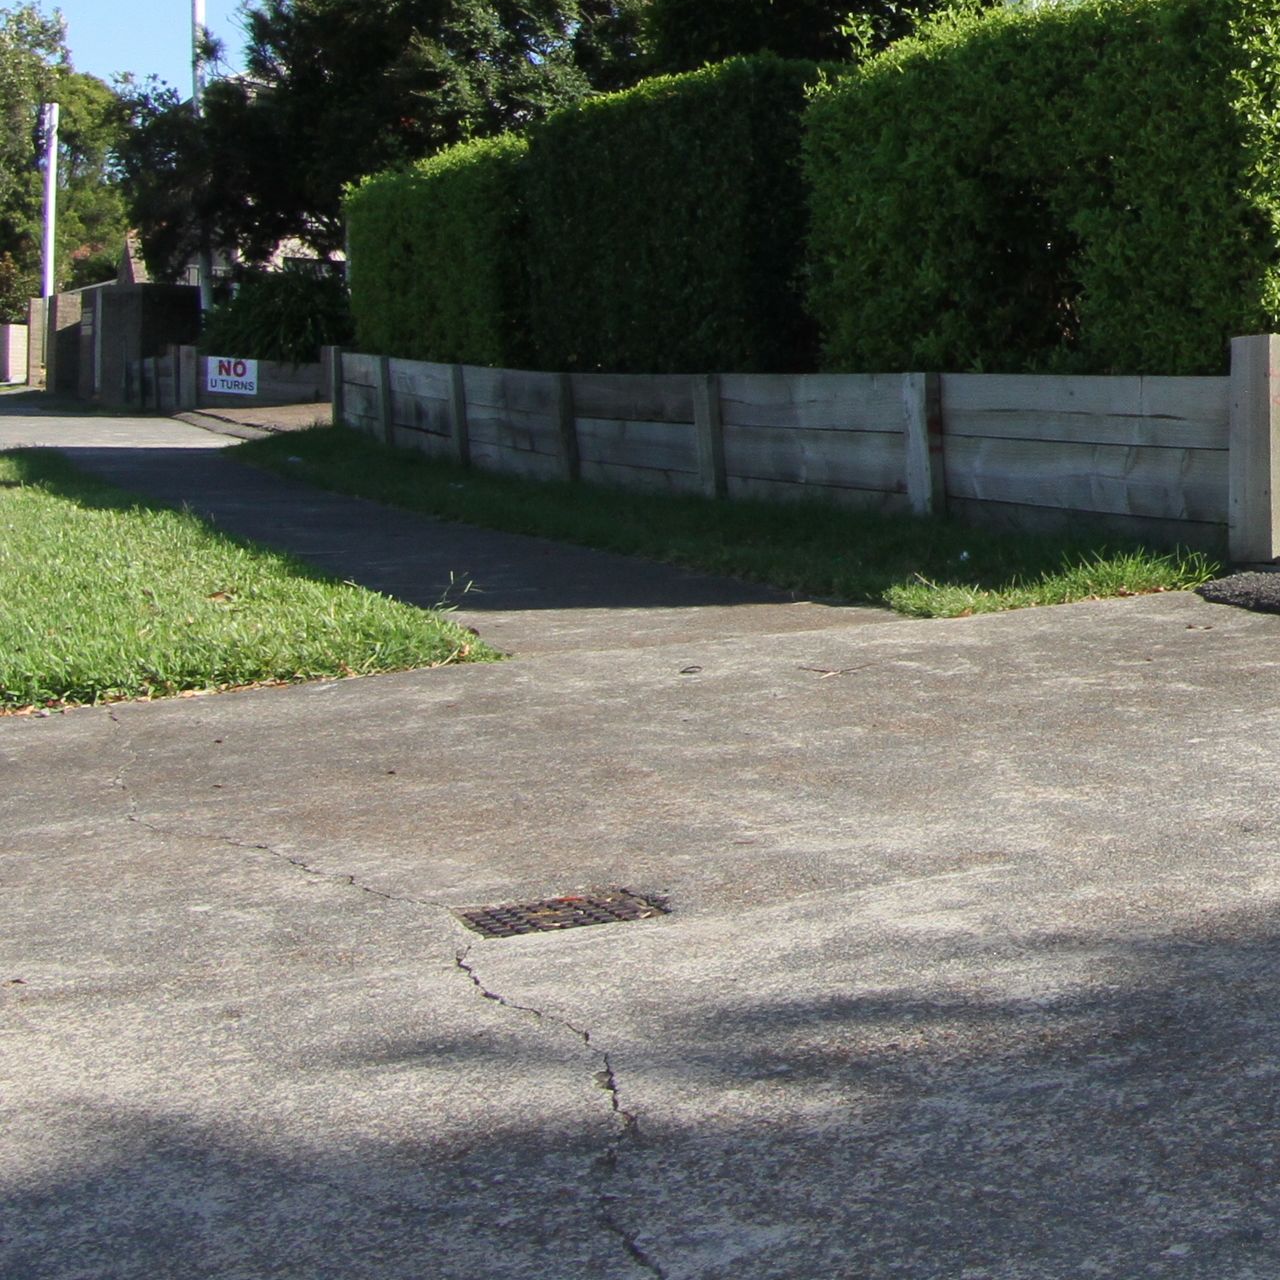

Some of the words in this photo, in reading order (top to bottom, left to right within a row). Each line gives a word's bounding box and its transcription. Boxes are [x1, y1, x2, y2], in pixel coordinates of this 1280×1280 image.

[219, 360, 247, 377] NO
[210, 379, 217, 388] U
[220, 379, 255, 391] TURNS
